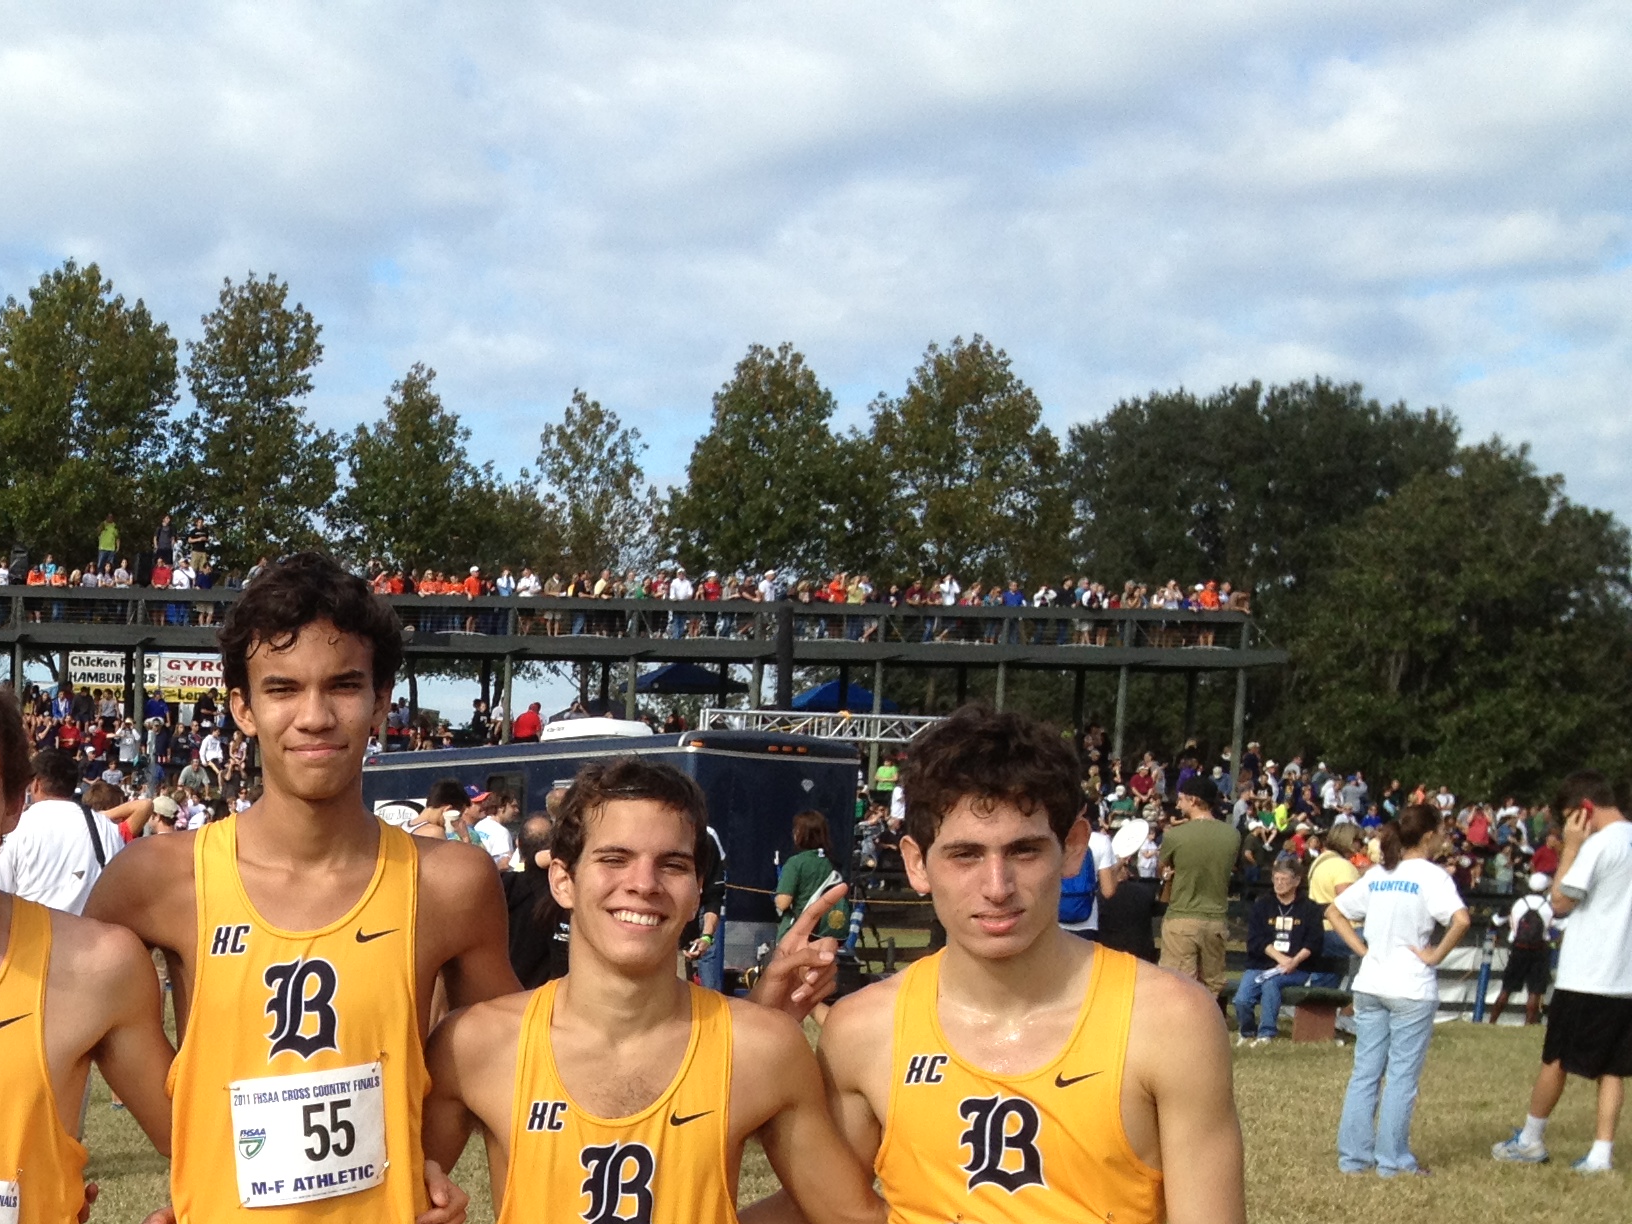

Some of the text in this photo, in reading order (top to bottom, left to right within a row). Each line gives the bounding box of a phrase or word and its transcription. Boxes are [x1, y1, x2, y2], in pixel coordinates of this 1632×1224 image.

[69, 671, 157, 684] HAMBURRS
[263, 955, 341, 1065] B
[234, 1075, 380, 1106] 2011 FHSAA CROSS COUNTRY FINALS
[240, 1128, 266, 1137] FHSAA
[302, 1098, 356, 1162] 55
[958, 1092, 1049, 1195] B
[251, 1180, 285, 1195] M-F
[293, 1164, 374, 1192] ATHLETIC
